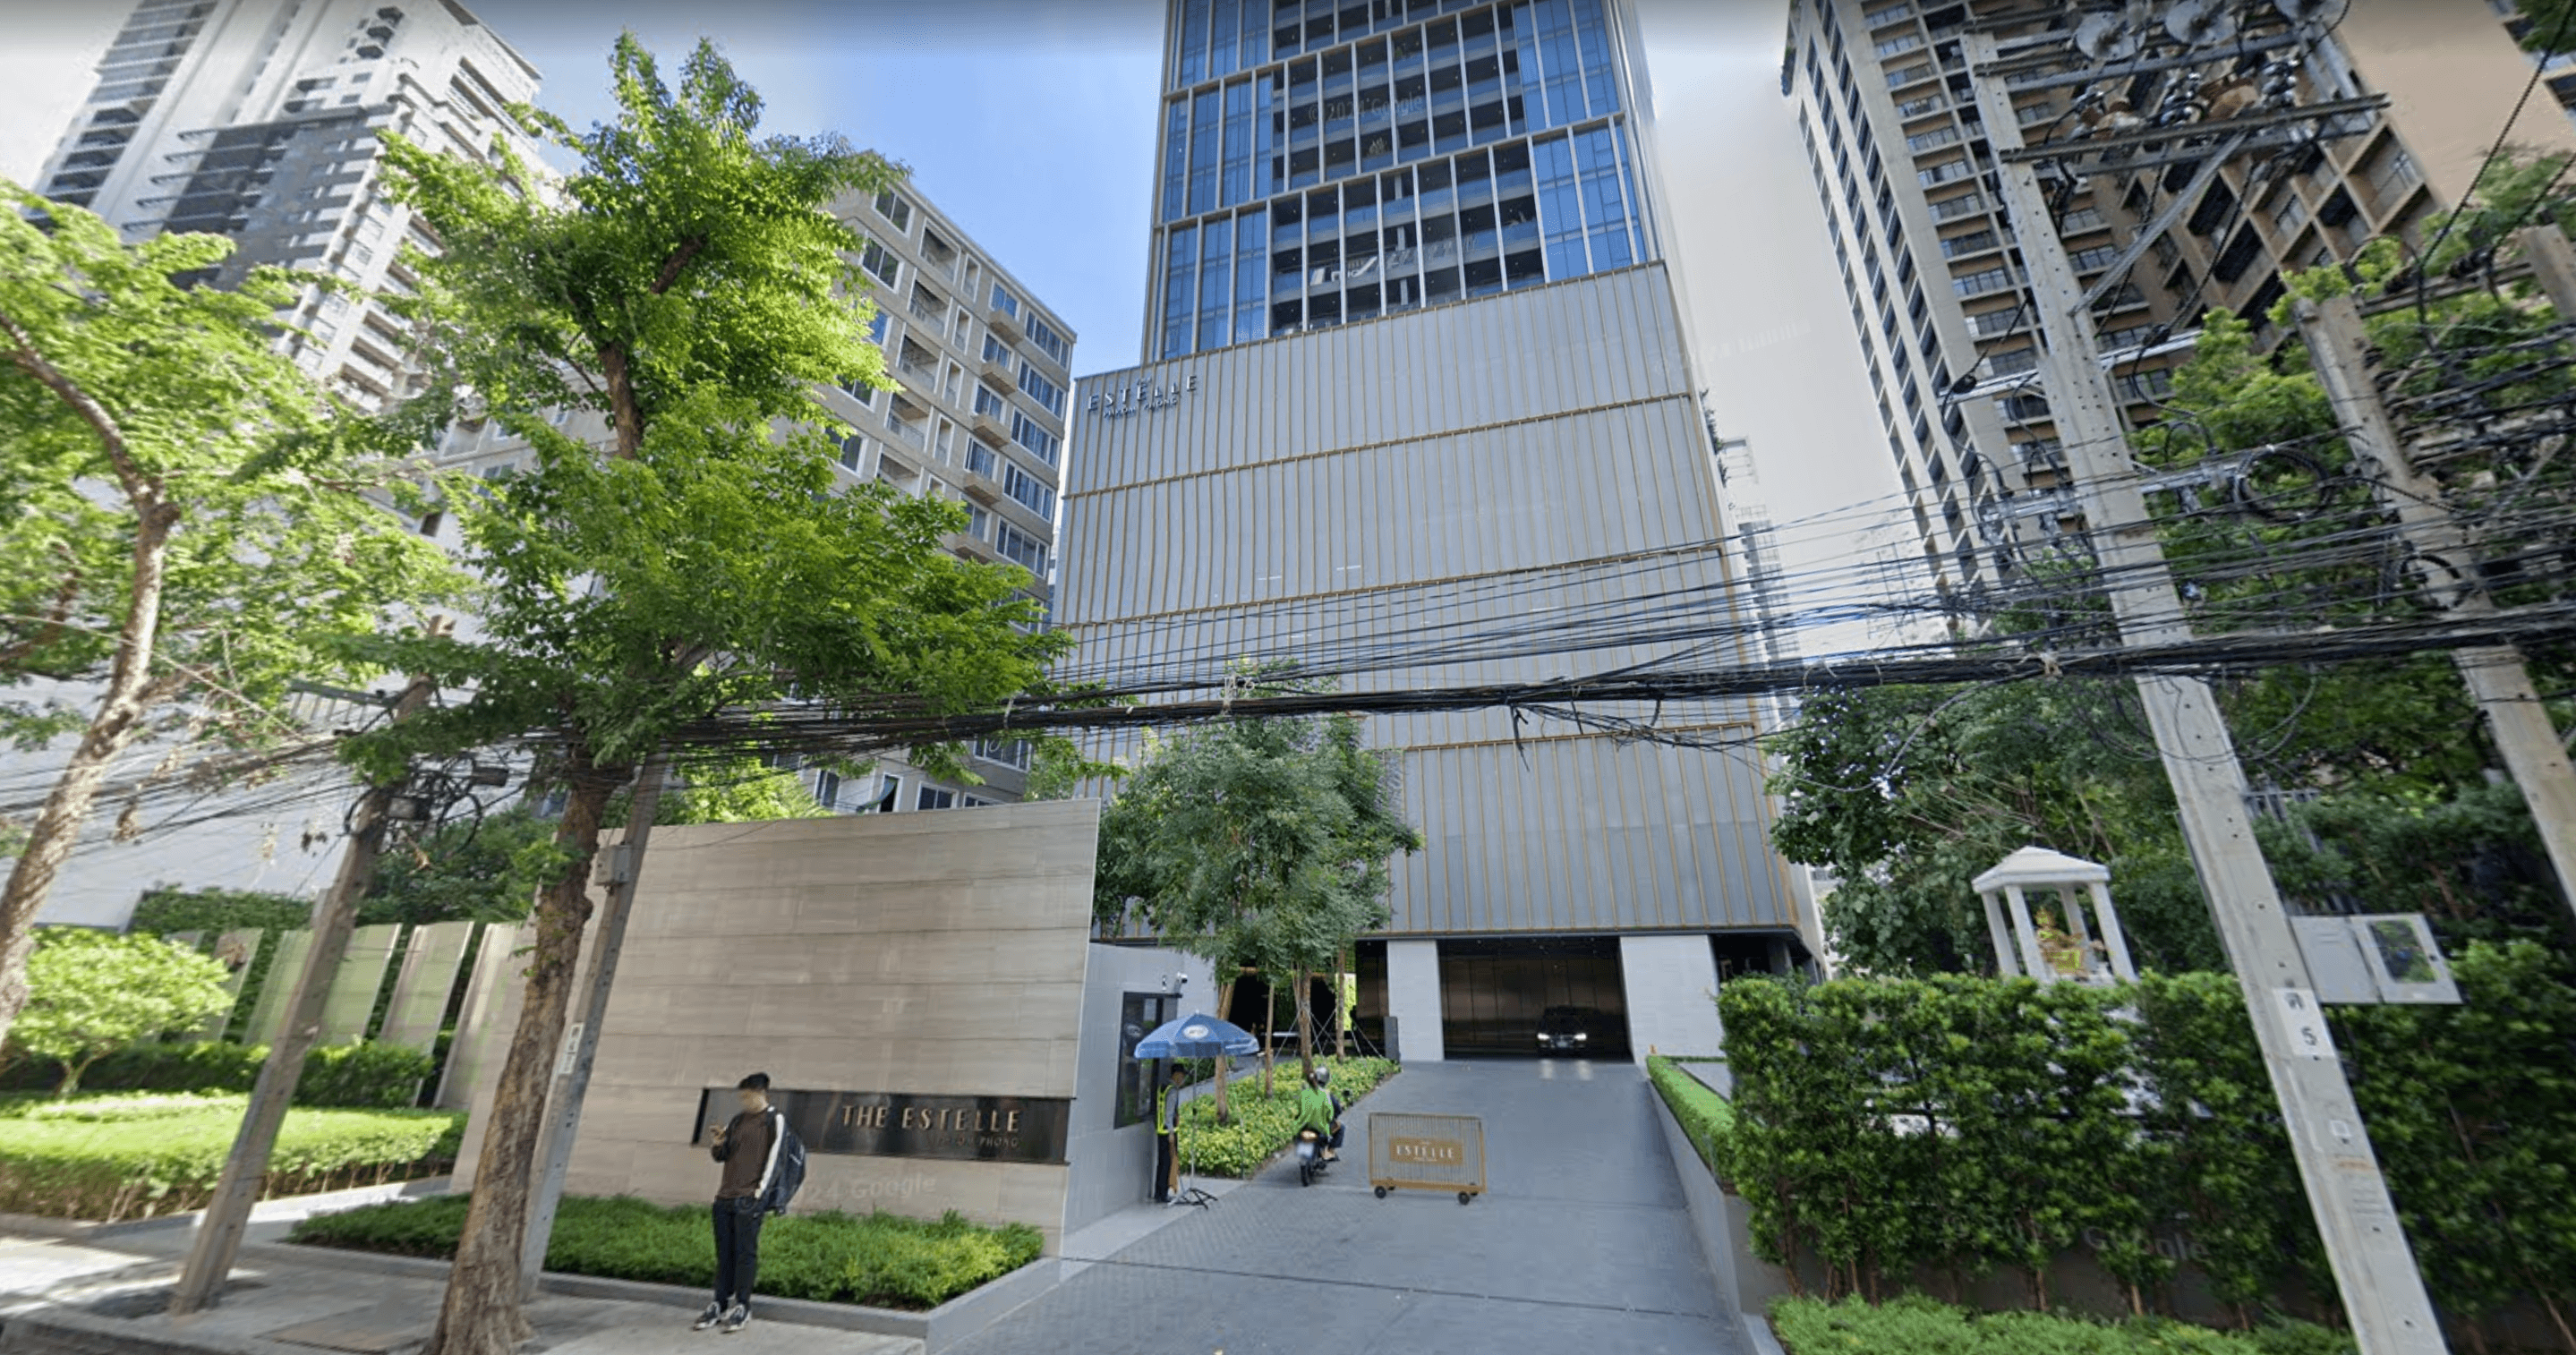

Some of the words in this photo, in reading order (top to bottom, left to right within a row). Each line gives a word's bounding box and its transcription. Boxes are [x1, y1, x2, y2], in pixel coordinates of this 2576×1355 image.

[1088, 375, 1198, 412] ESTELLE
[2300, 1027, 2317, 1046] 5
[842, 1105, 888, 1129] THE
[902, 1107, 1020, 1132] ESTELLE
